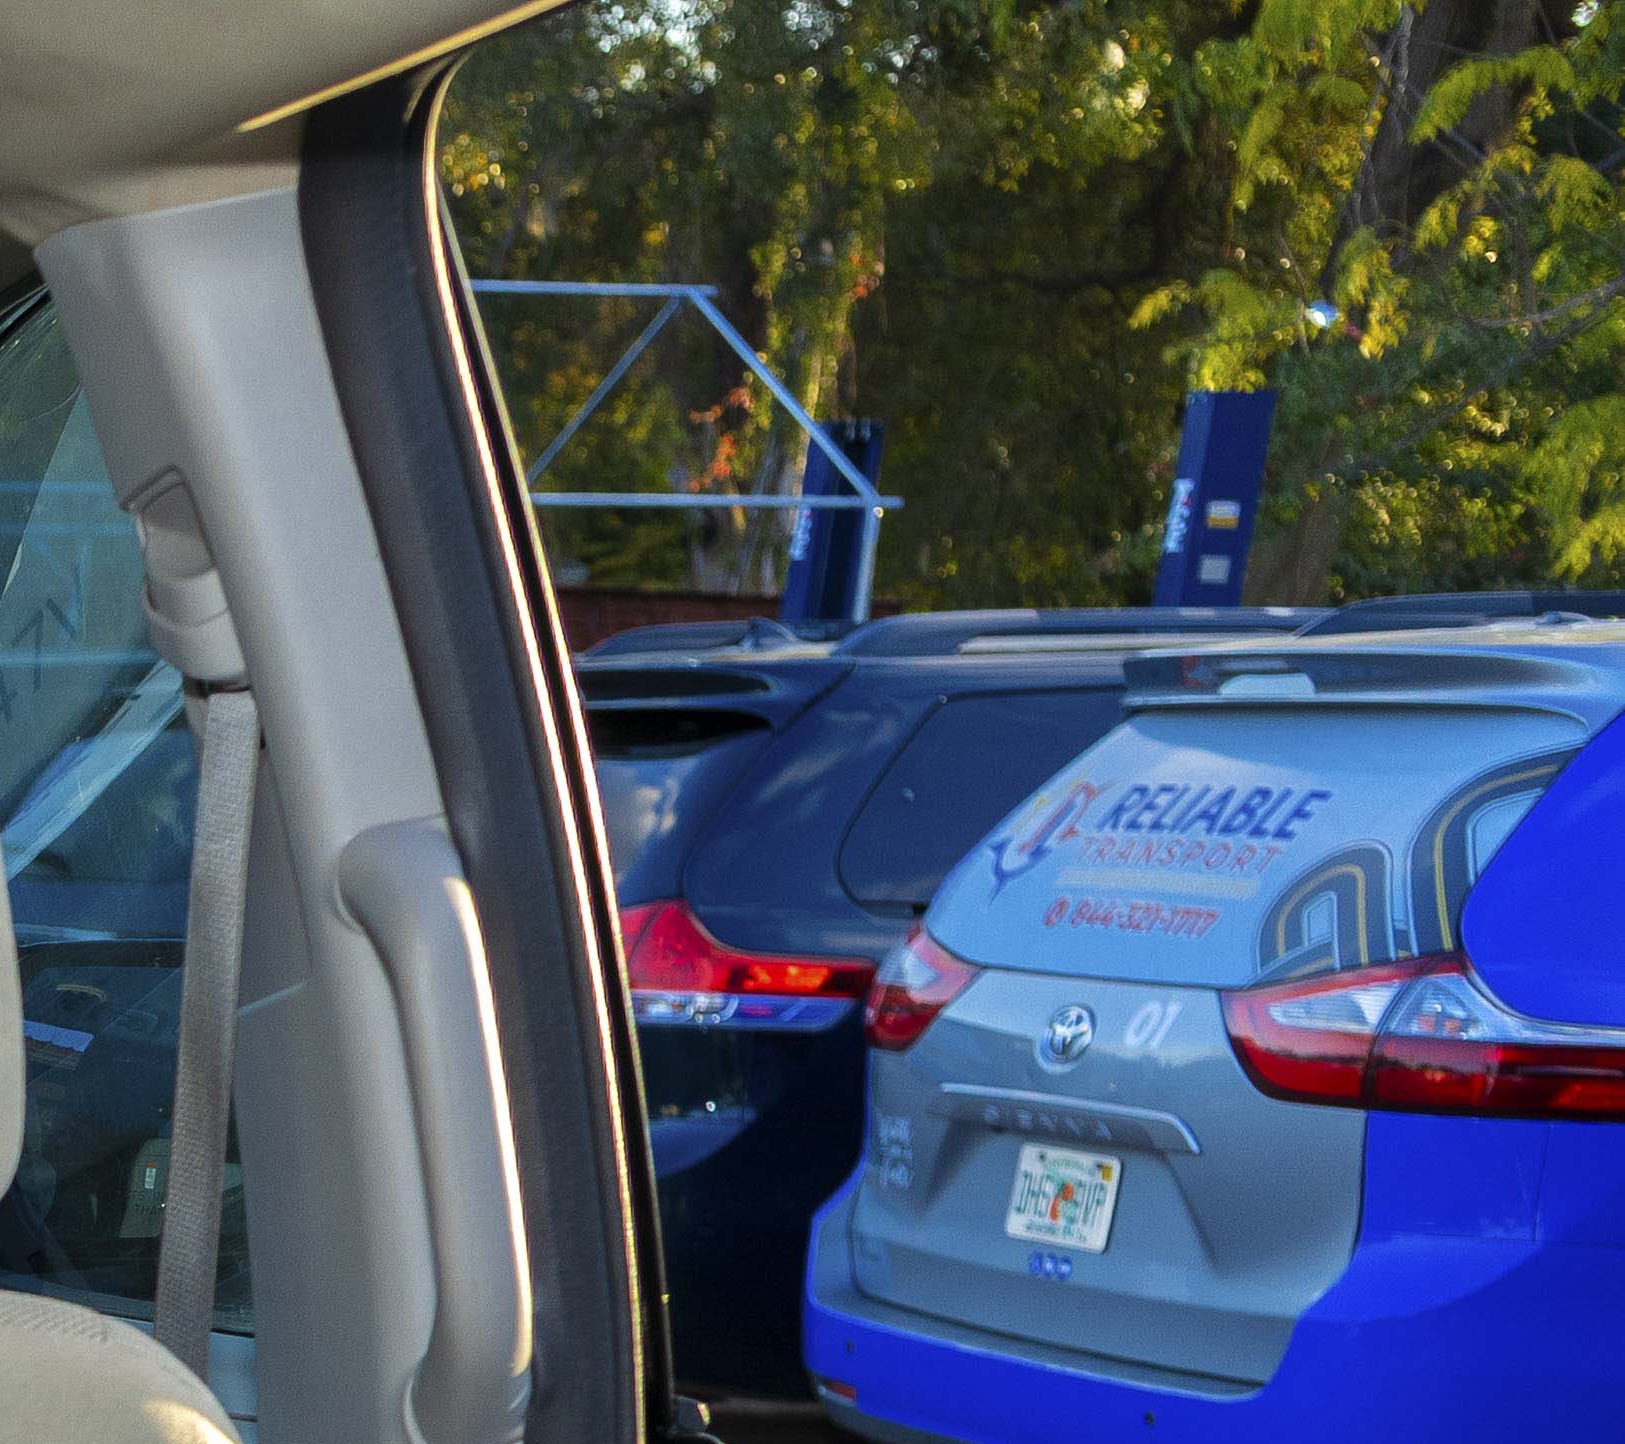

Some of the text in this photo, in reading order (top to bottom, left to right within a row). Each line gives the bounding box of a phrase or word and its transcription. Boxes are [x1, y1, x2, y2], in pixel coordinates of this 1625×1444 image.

[1095, 783, 1333, 841] RELIABLE
[1078, 836, 1284, 873] TRANSPORT
[1125, 1000, 1184, 1050] 01
